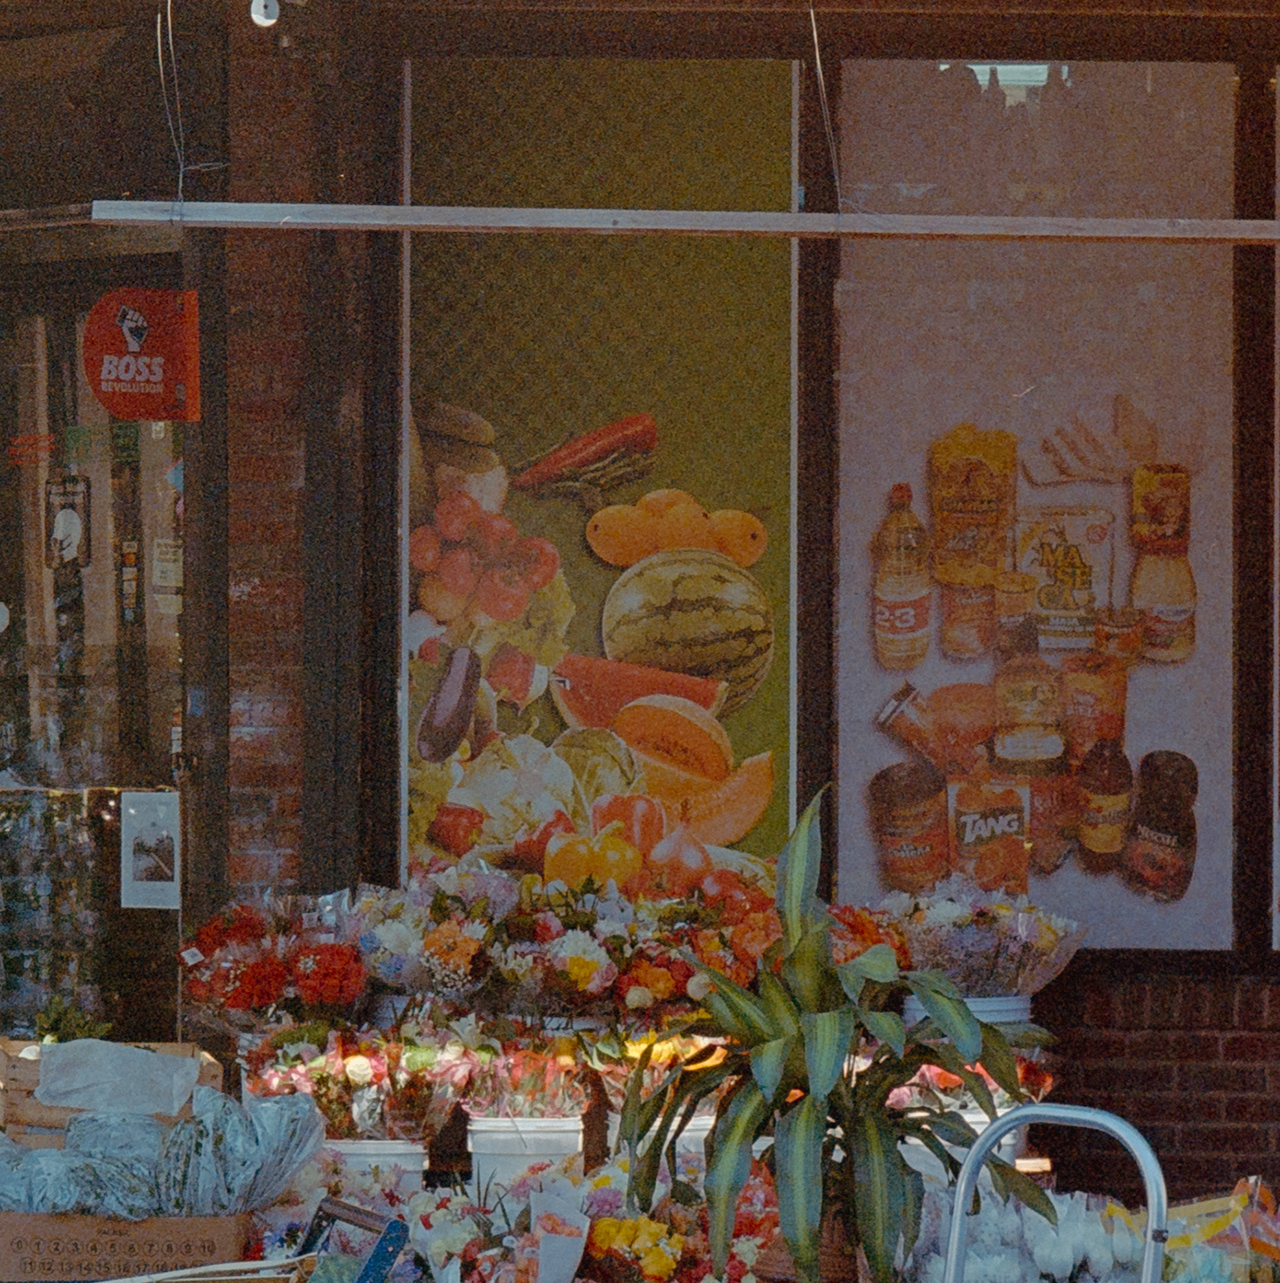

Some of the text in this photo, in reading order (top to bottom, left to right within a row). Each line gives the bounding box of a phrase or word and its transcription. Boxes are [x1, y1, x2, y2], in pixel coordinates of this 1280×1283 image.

[101, 354, 165, 383] BOSS
[101, 382, 163, 393] REVOLUTION
[960, 814, 1019, 843] TANG
